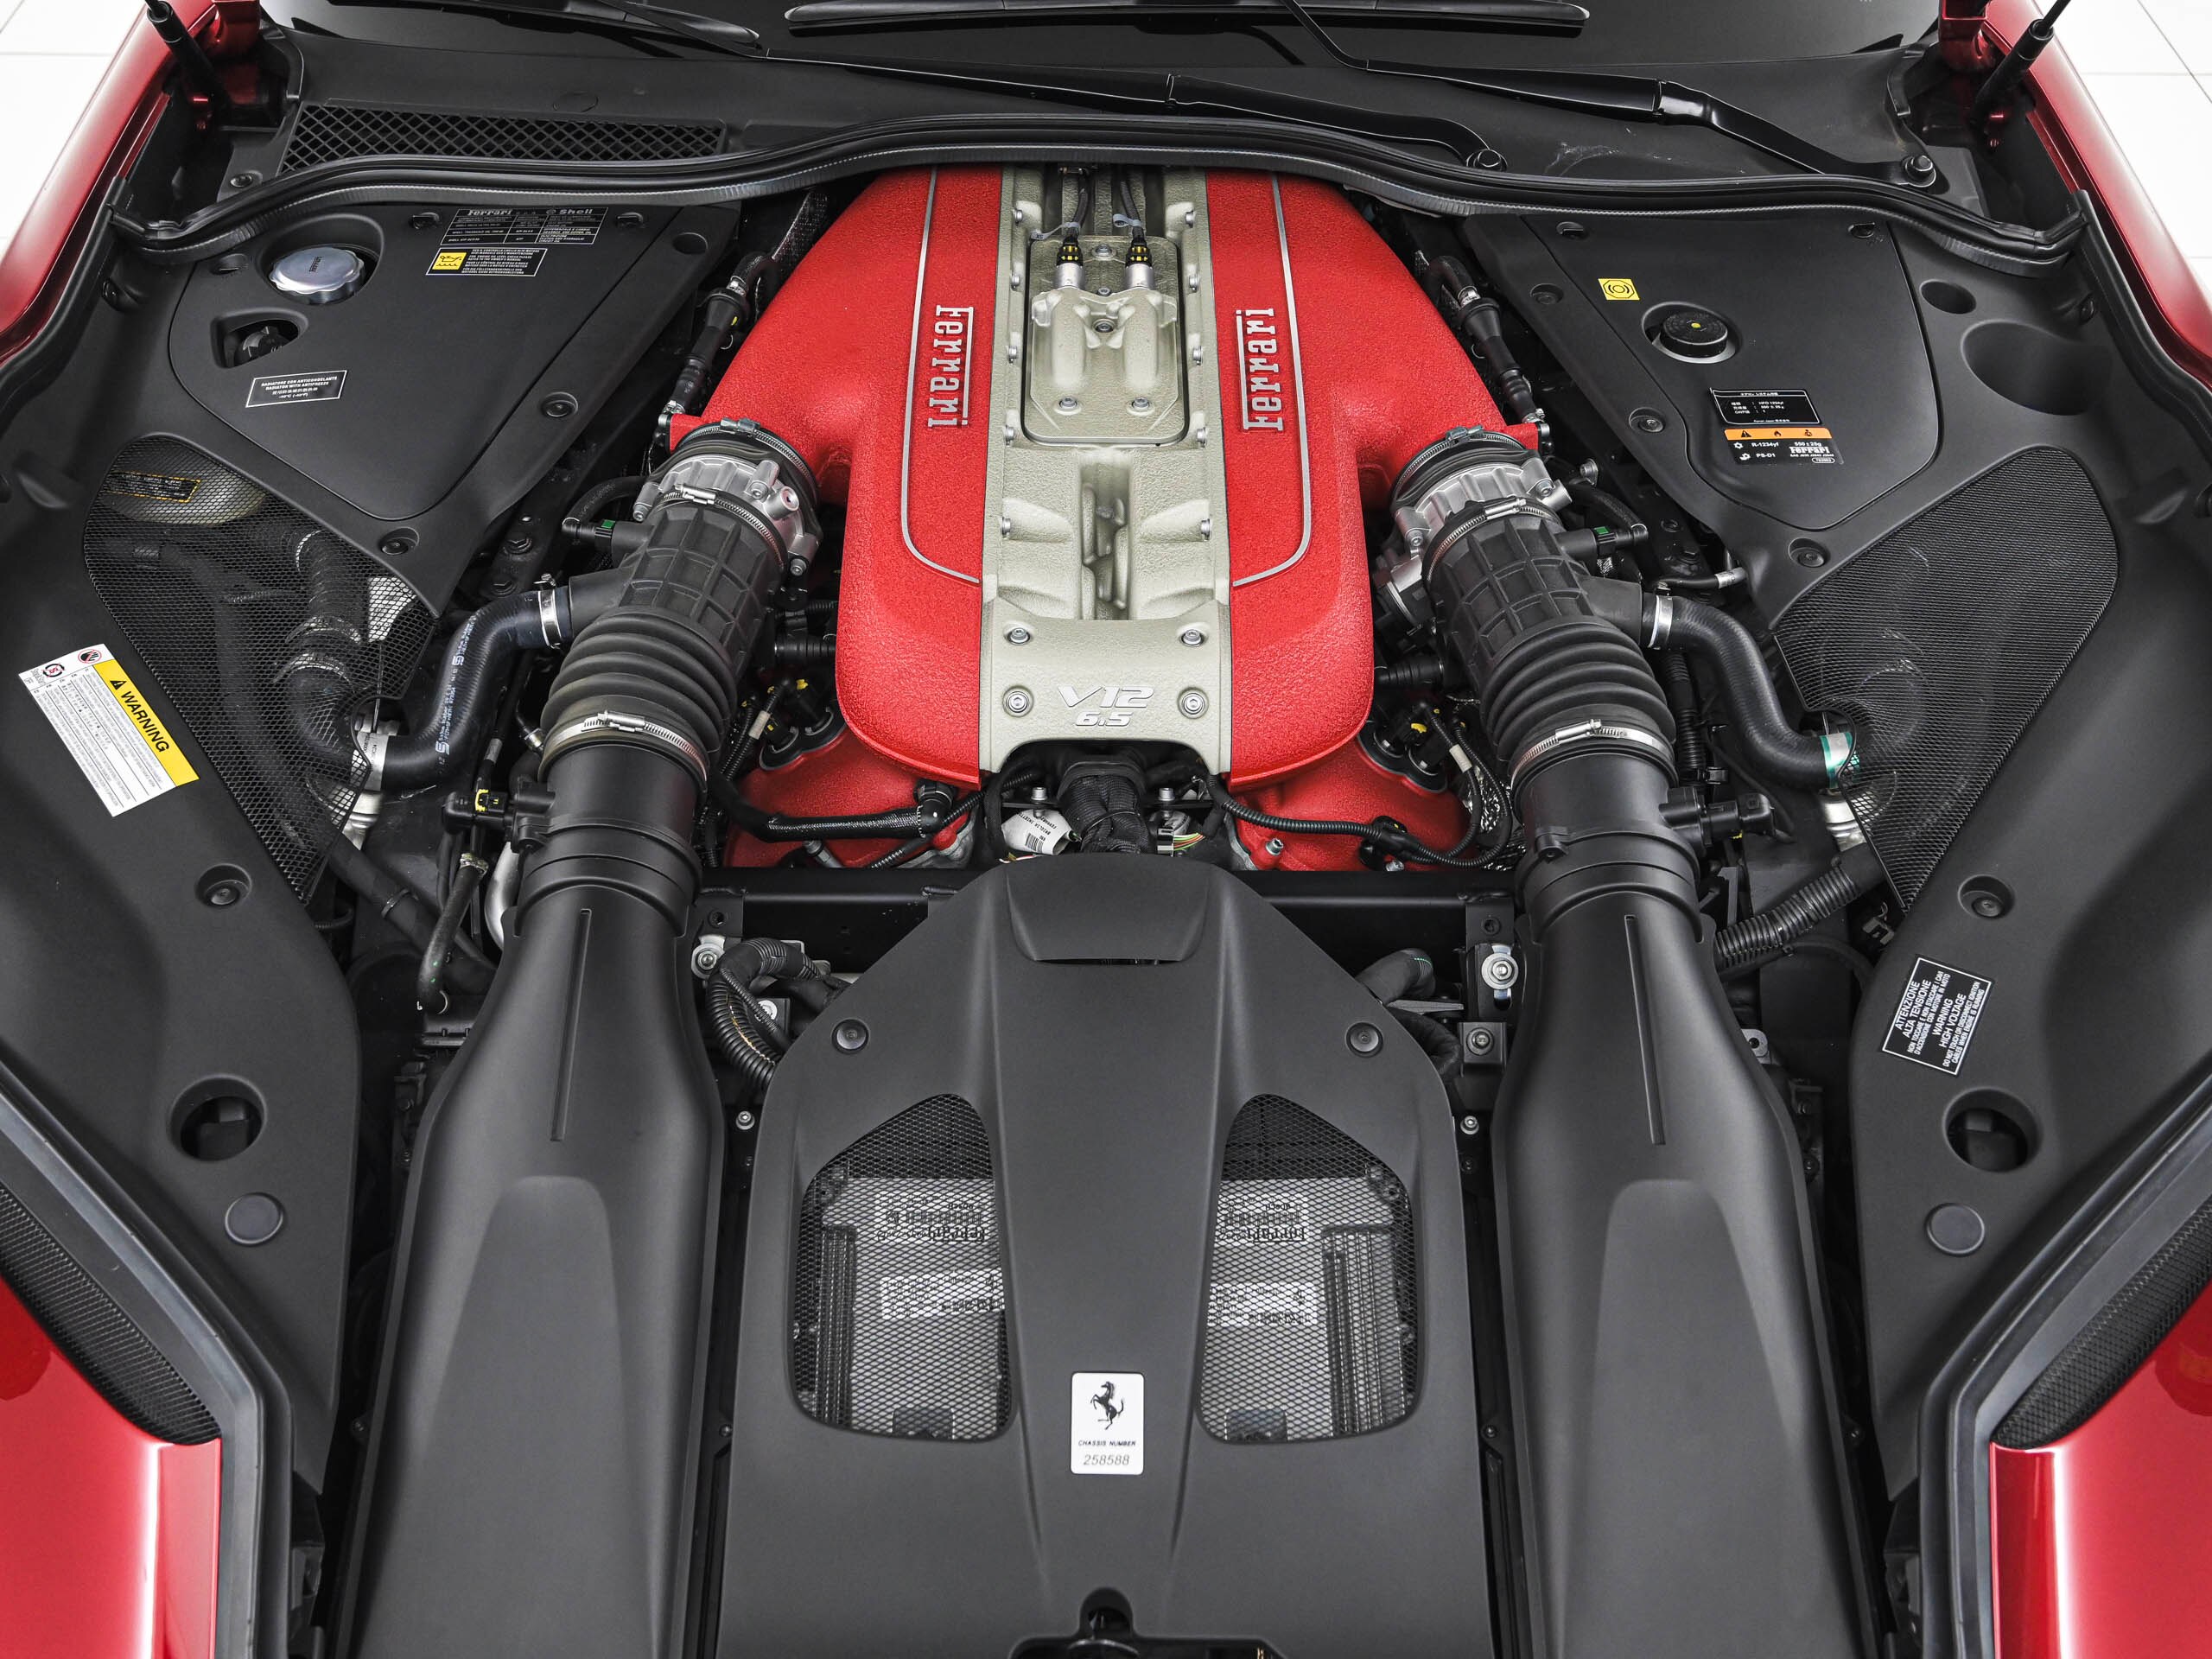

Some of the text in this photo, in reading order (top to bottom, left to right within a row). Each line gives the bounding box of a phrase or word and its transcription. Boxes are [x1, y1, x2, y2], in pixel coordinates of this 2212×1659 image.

[927, 304, 974, 428] Ferrari
[1235, 307, 1284, 431] Ferrari
[1058, 685, 1154, 708] V12
[121, 690, 169, 753] WARNING
[1075, 712, 1134, 726] 6.5
[1925, 984, 1939, 1006] STACCARE
[1930, 993, 1942, 1013] MOTORE
[1940, 973, 1951, 988] MOTO
[1968, 982, 1980, 1000] IGNITION
[1895, 981, 1920, 1030] ATTENZIONE
[1902, 979, 1931, 1038] ALTA TENSIONE
[1921, 1007, 1930, 1018] NON
[1932, 998, 1953, 1036] WARNING
[1958, 1000, 1973, 1027] DISCONNECT
[1911, 1021, 1924, 1041] TOCCARE
[1938, 993, 1967, 1048] HIGH VOLTAGE
[1907, 1042, 1916, 1053] NON
[1949, 1034, 1960, 1050] TOUCH
[1951, 1046, 1963, 1064] CABLES
[1958, 1032, 1968, 1046] WHEN
[1963, 1015, 1975, 1032] ENGINE
[1942, 1058, 1951, 1067] DO
[1945, 1049, 1954, 1060] NOT
[1084, 1454, 1130, 1465] 258588
